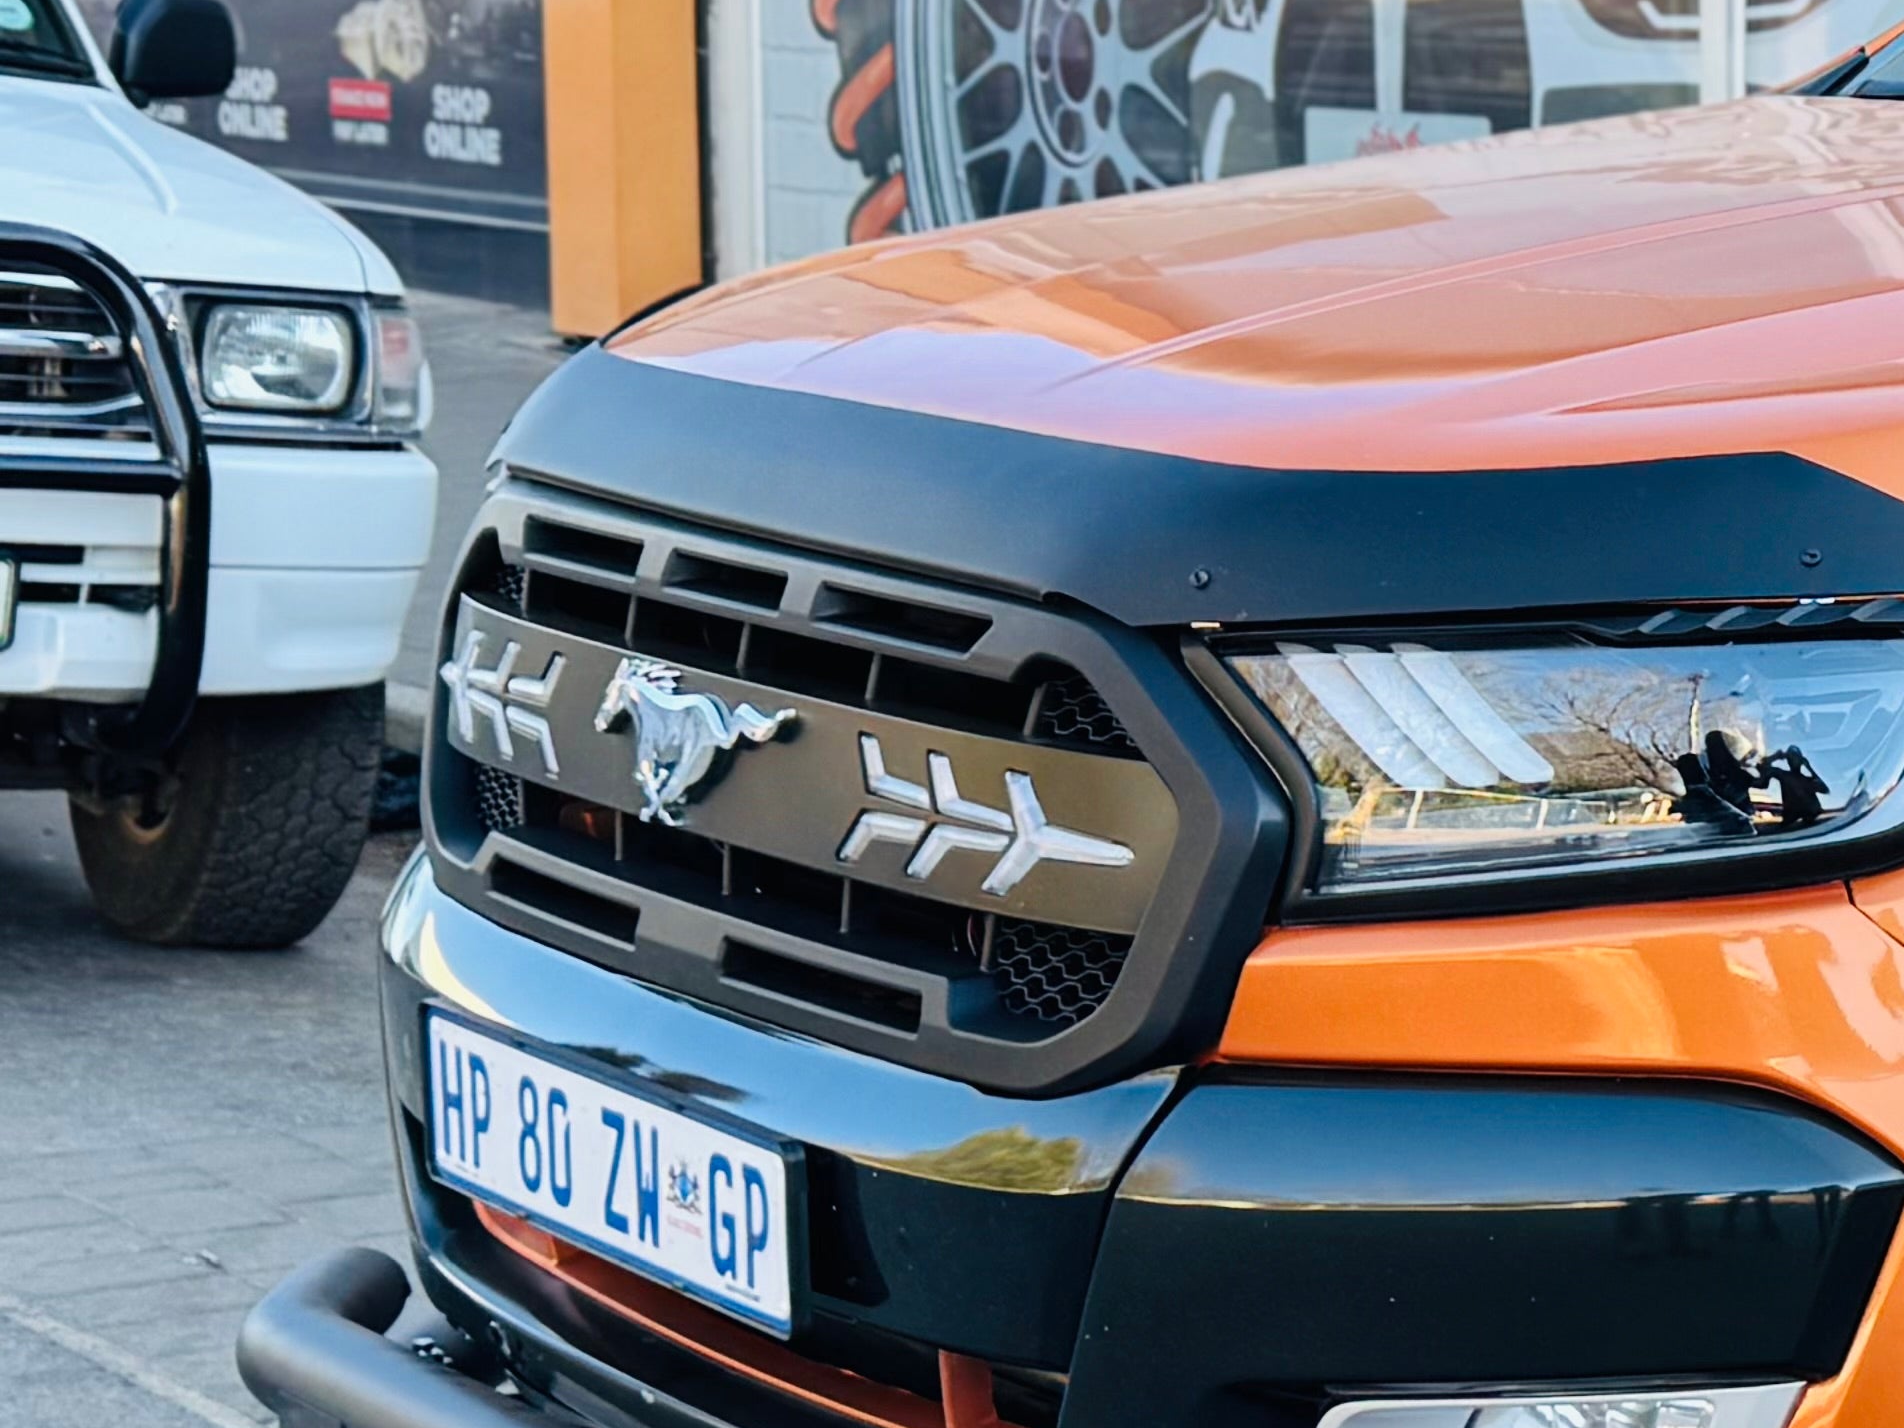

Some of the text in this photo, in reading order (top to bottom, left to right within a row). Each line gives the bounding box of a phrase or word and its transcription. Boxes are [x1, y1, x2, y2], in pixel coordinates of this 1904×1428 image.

[218, 99, 289, 142] ONLINE
[431, 83, 491, 124] SHOP
[423, 120, 502, 166] ONLINE
[439, 1038, 770, 1290] HP 80 ZW GP
